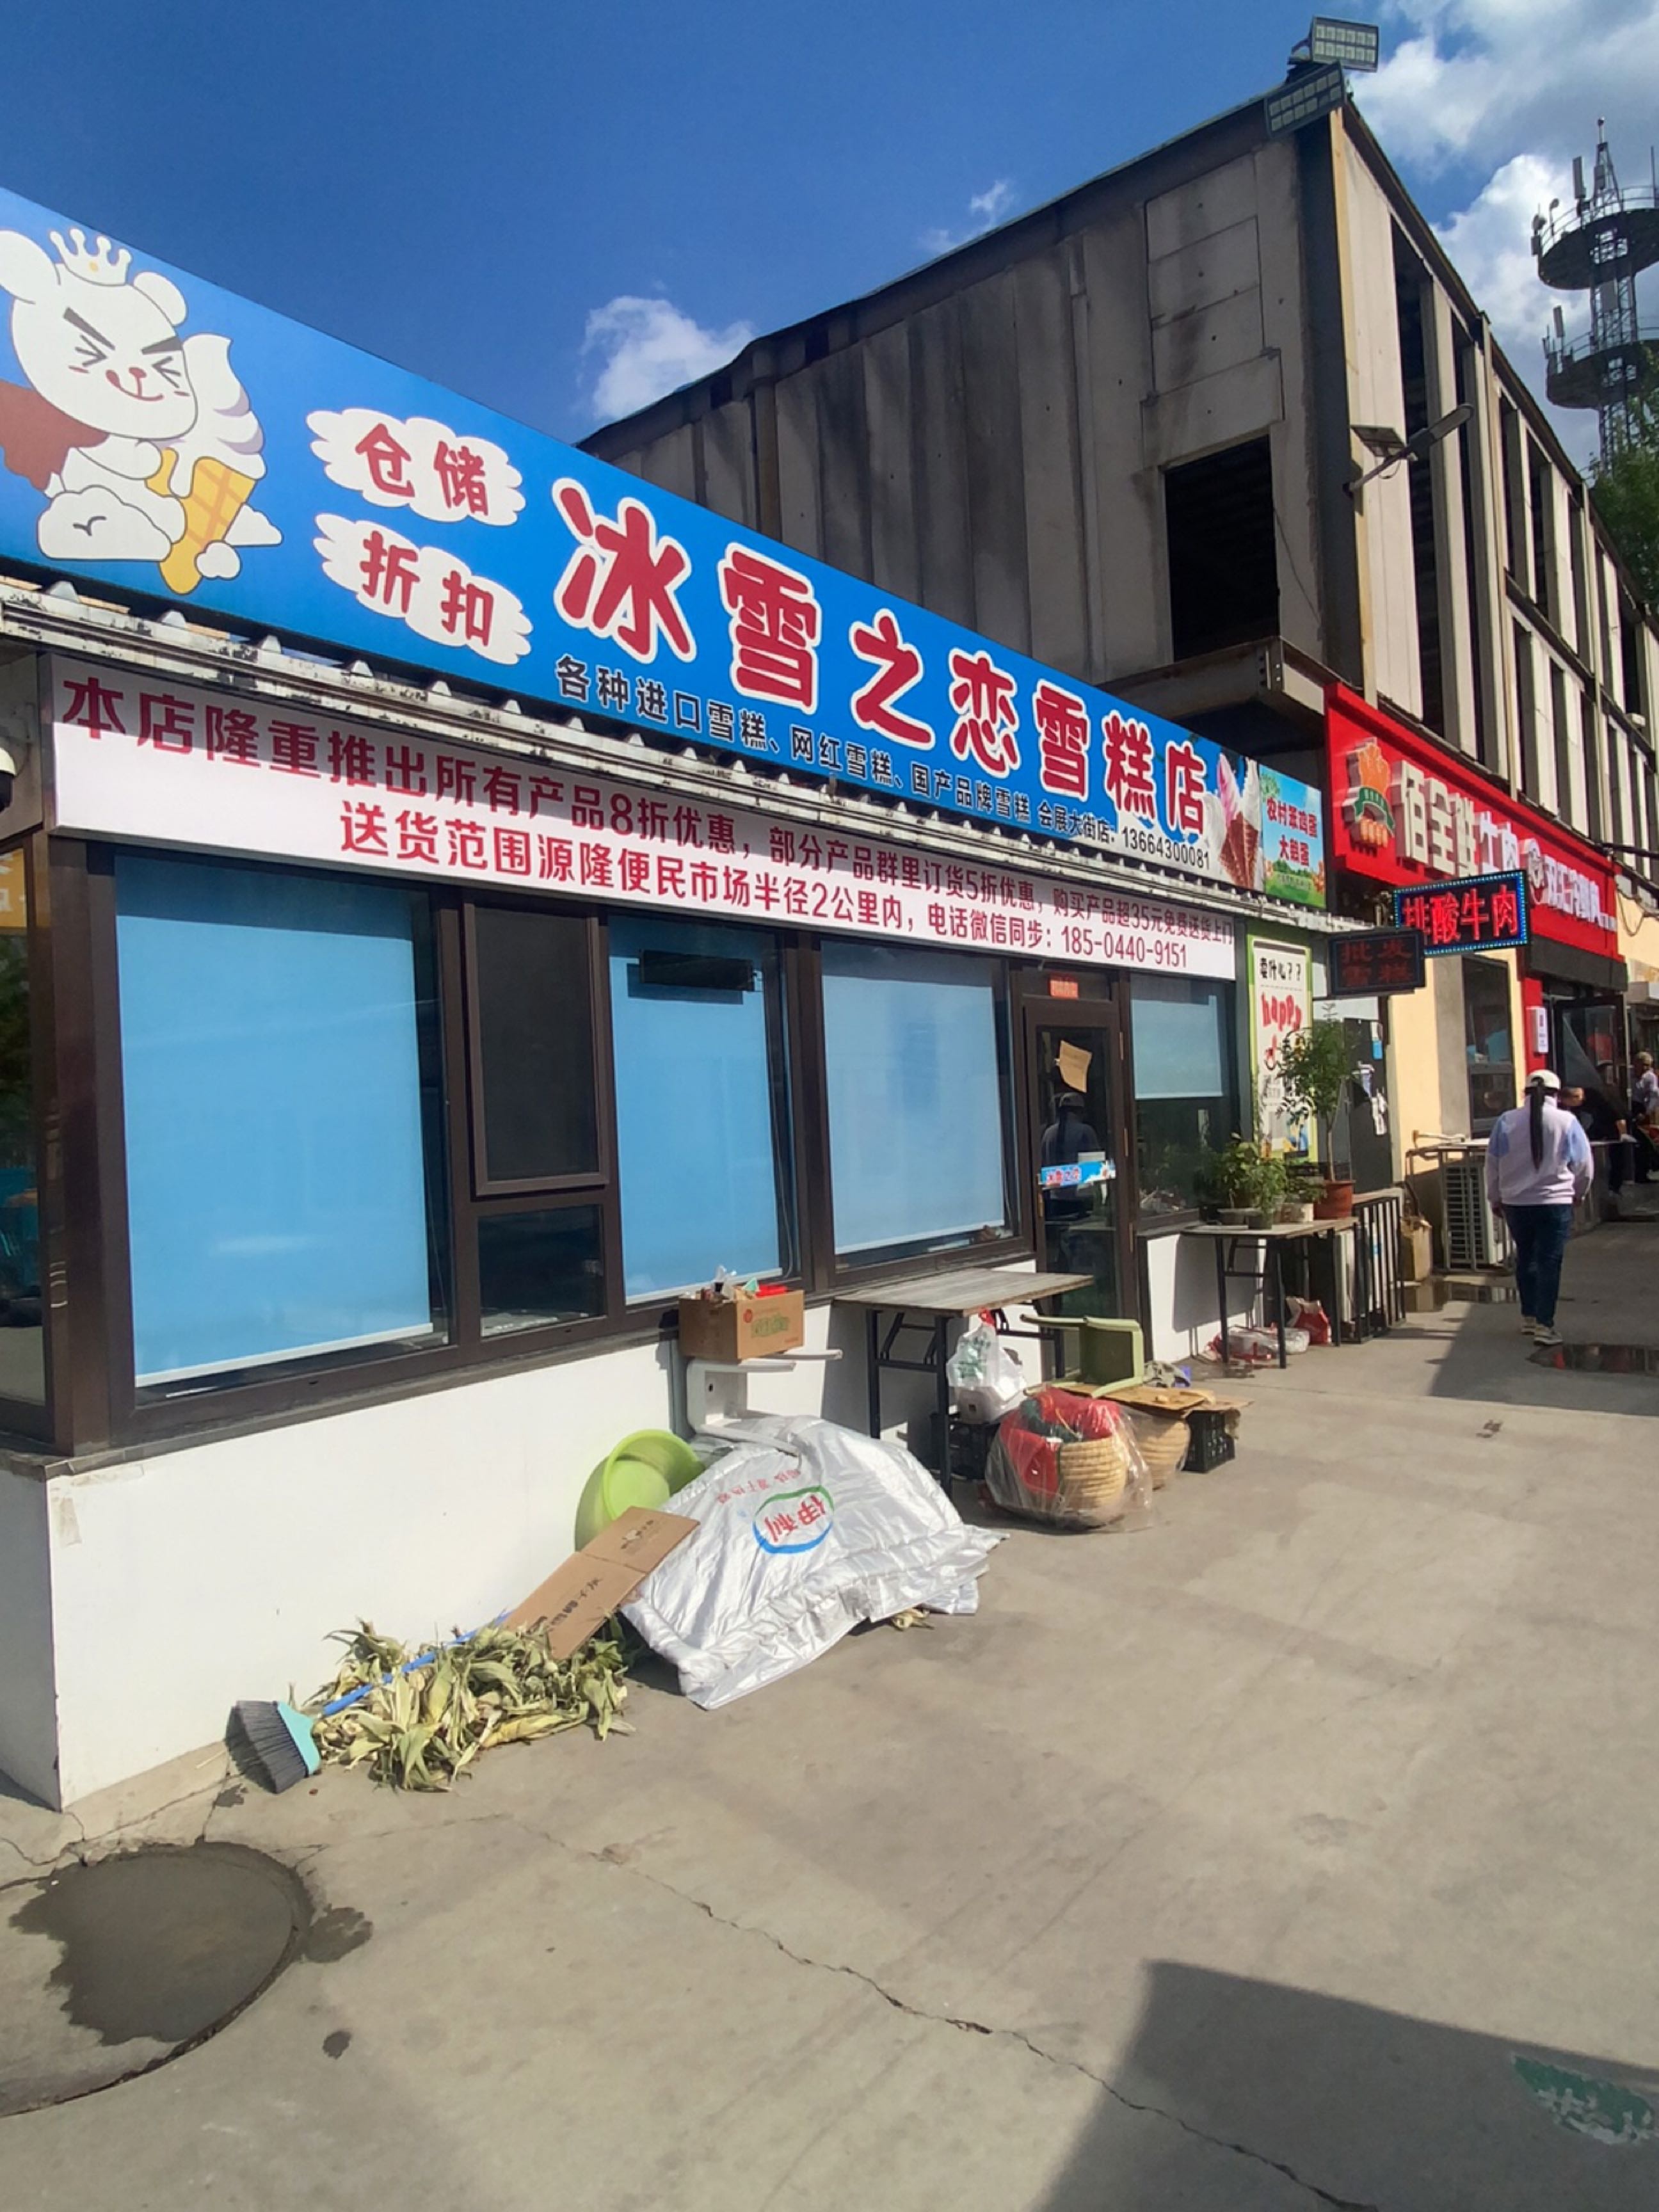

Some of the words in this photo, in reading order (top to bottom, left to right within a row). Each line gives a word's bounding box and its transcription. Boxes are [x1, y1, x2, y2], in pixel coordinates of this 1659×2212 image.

[355, 423, 489, 517] 仓储
[359, 530, 495, 646] 折扣
[557, 483, 1206, 835] 冰雪之恋雪糕店
[1402, 885, 1518, 945] 排酸牛肉
[765, 1495, 826, 1543] 伊利
